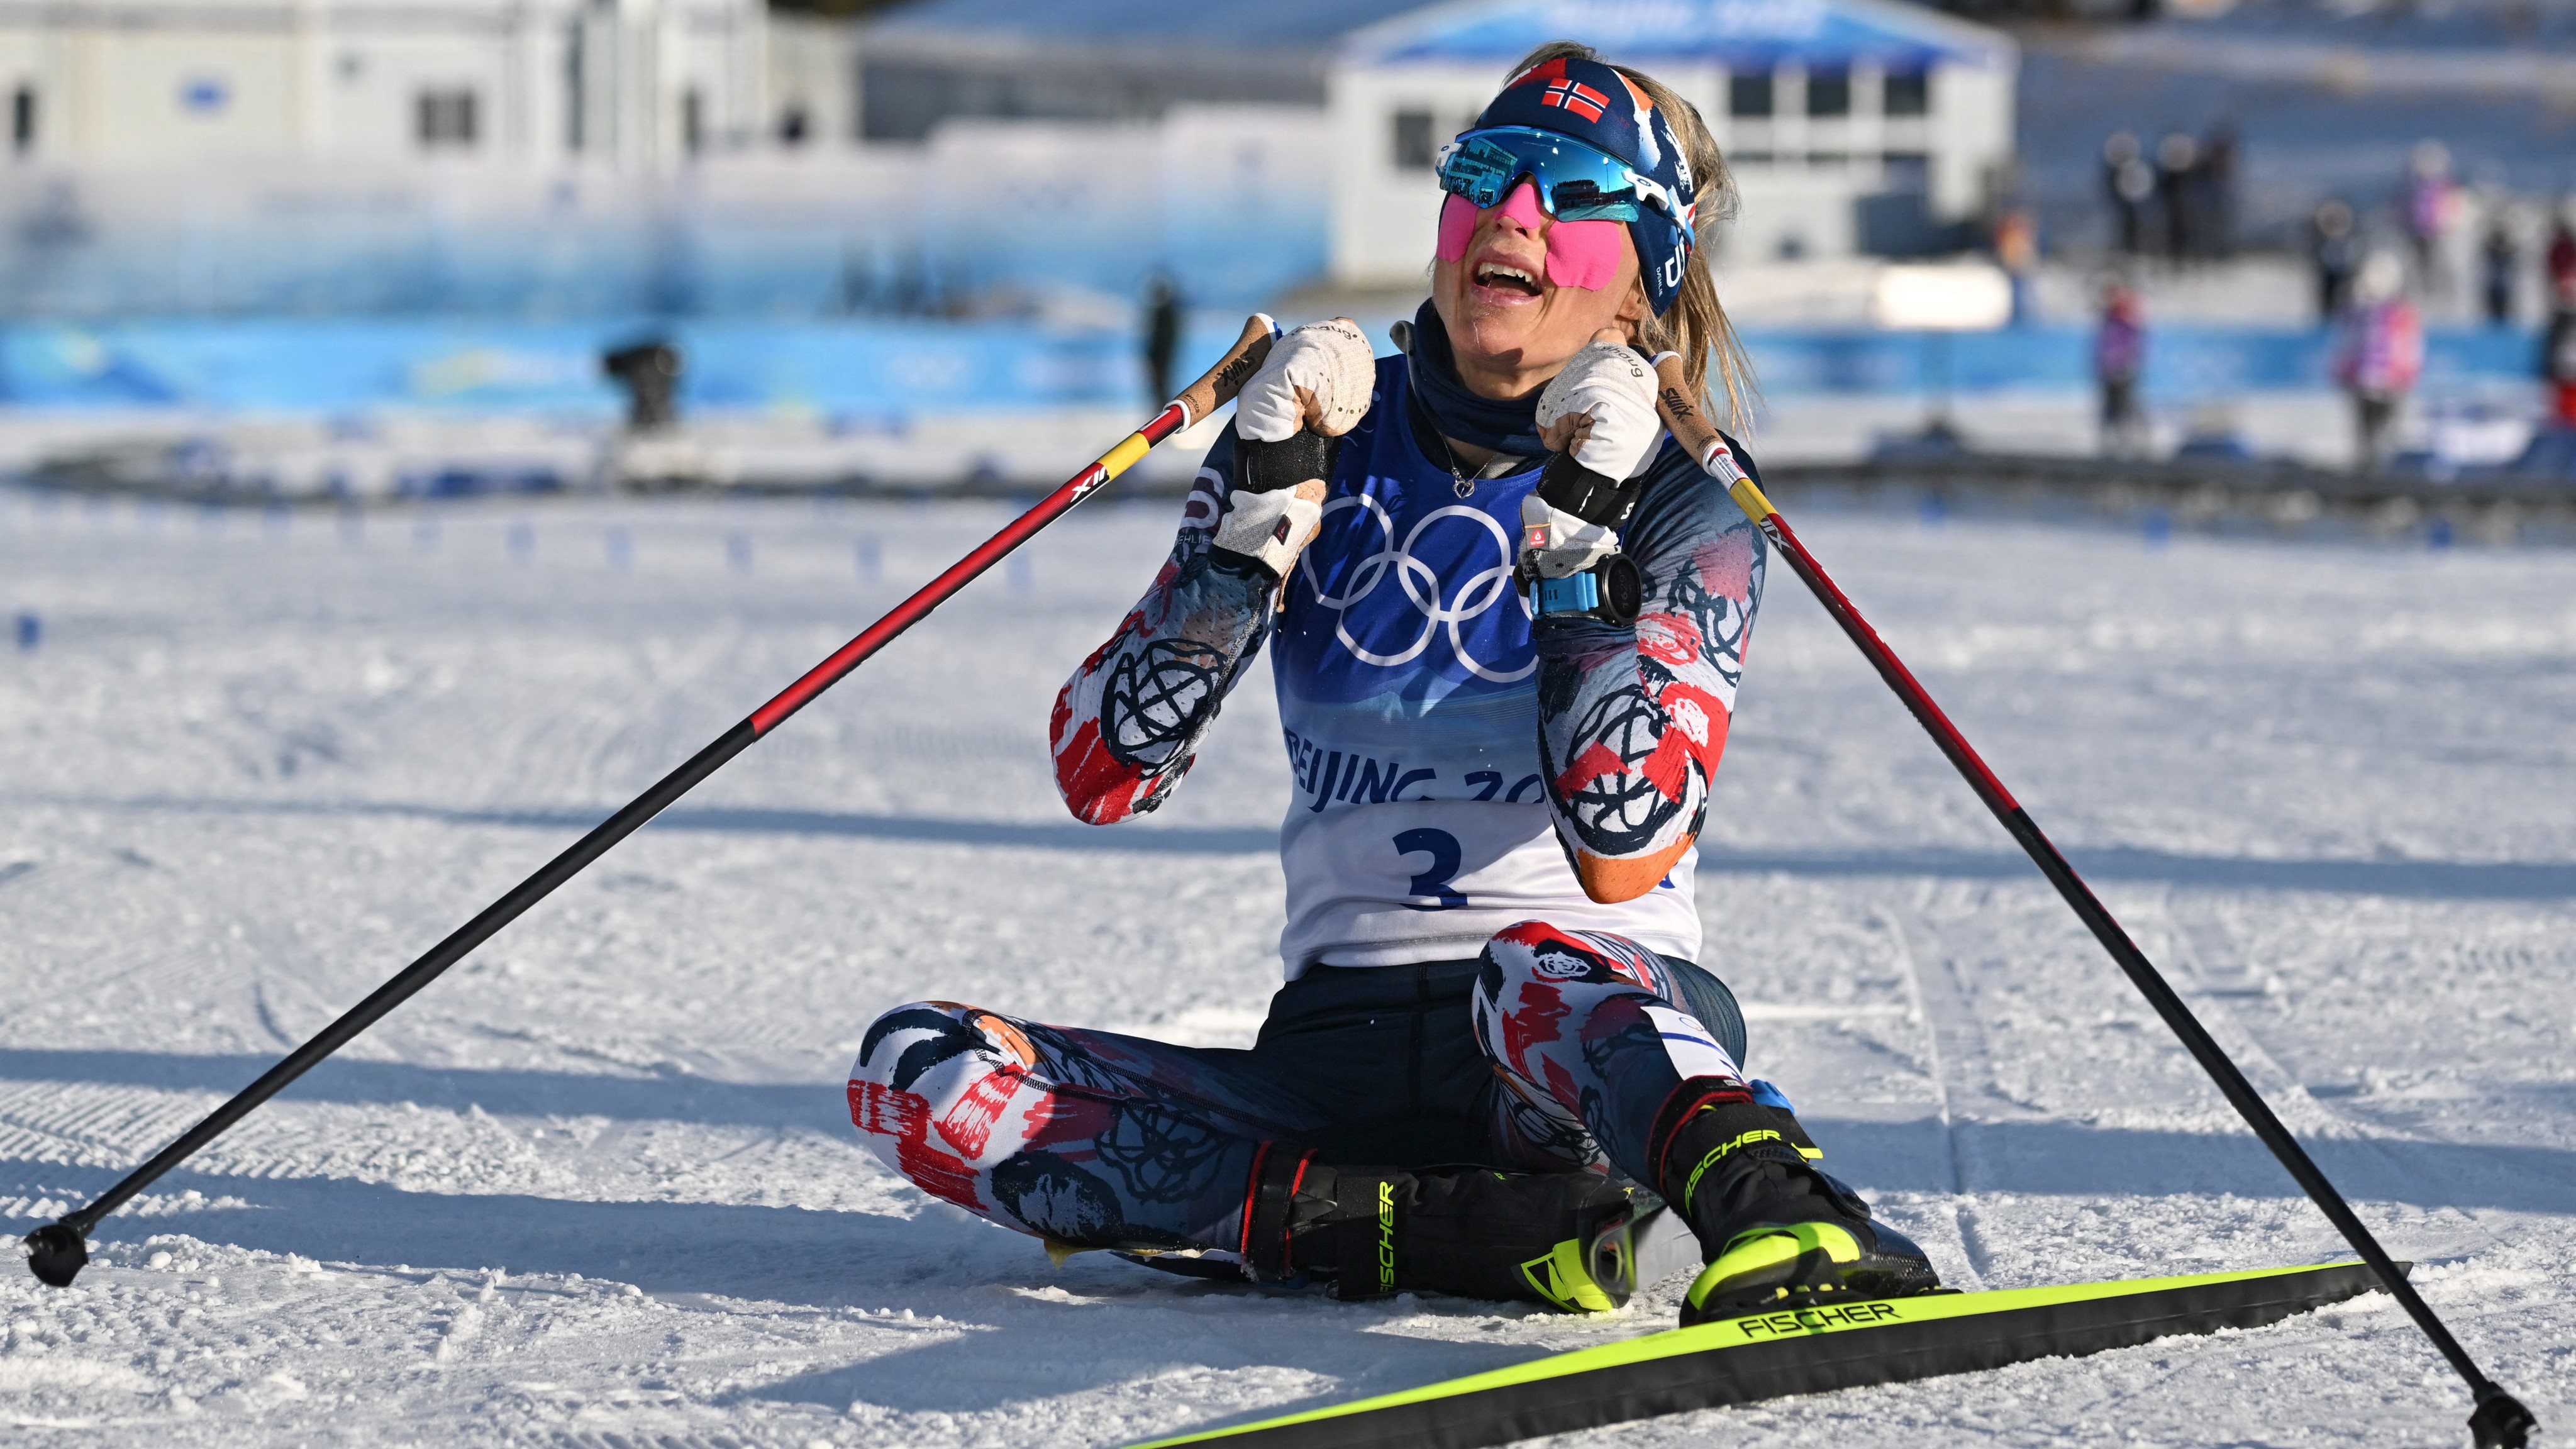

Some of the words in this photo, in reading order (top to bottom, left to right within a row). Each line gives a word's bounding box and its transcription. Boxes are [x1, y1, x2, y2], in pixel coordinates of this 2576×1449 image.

[1284, 726, 1436, 813] BEIJING
[1392, 828, 1468, 912] 3
[1738, 1303, 1903, 1338] FISCHER
